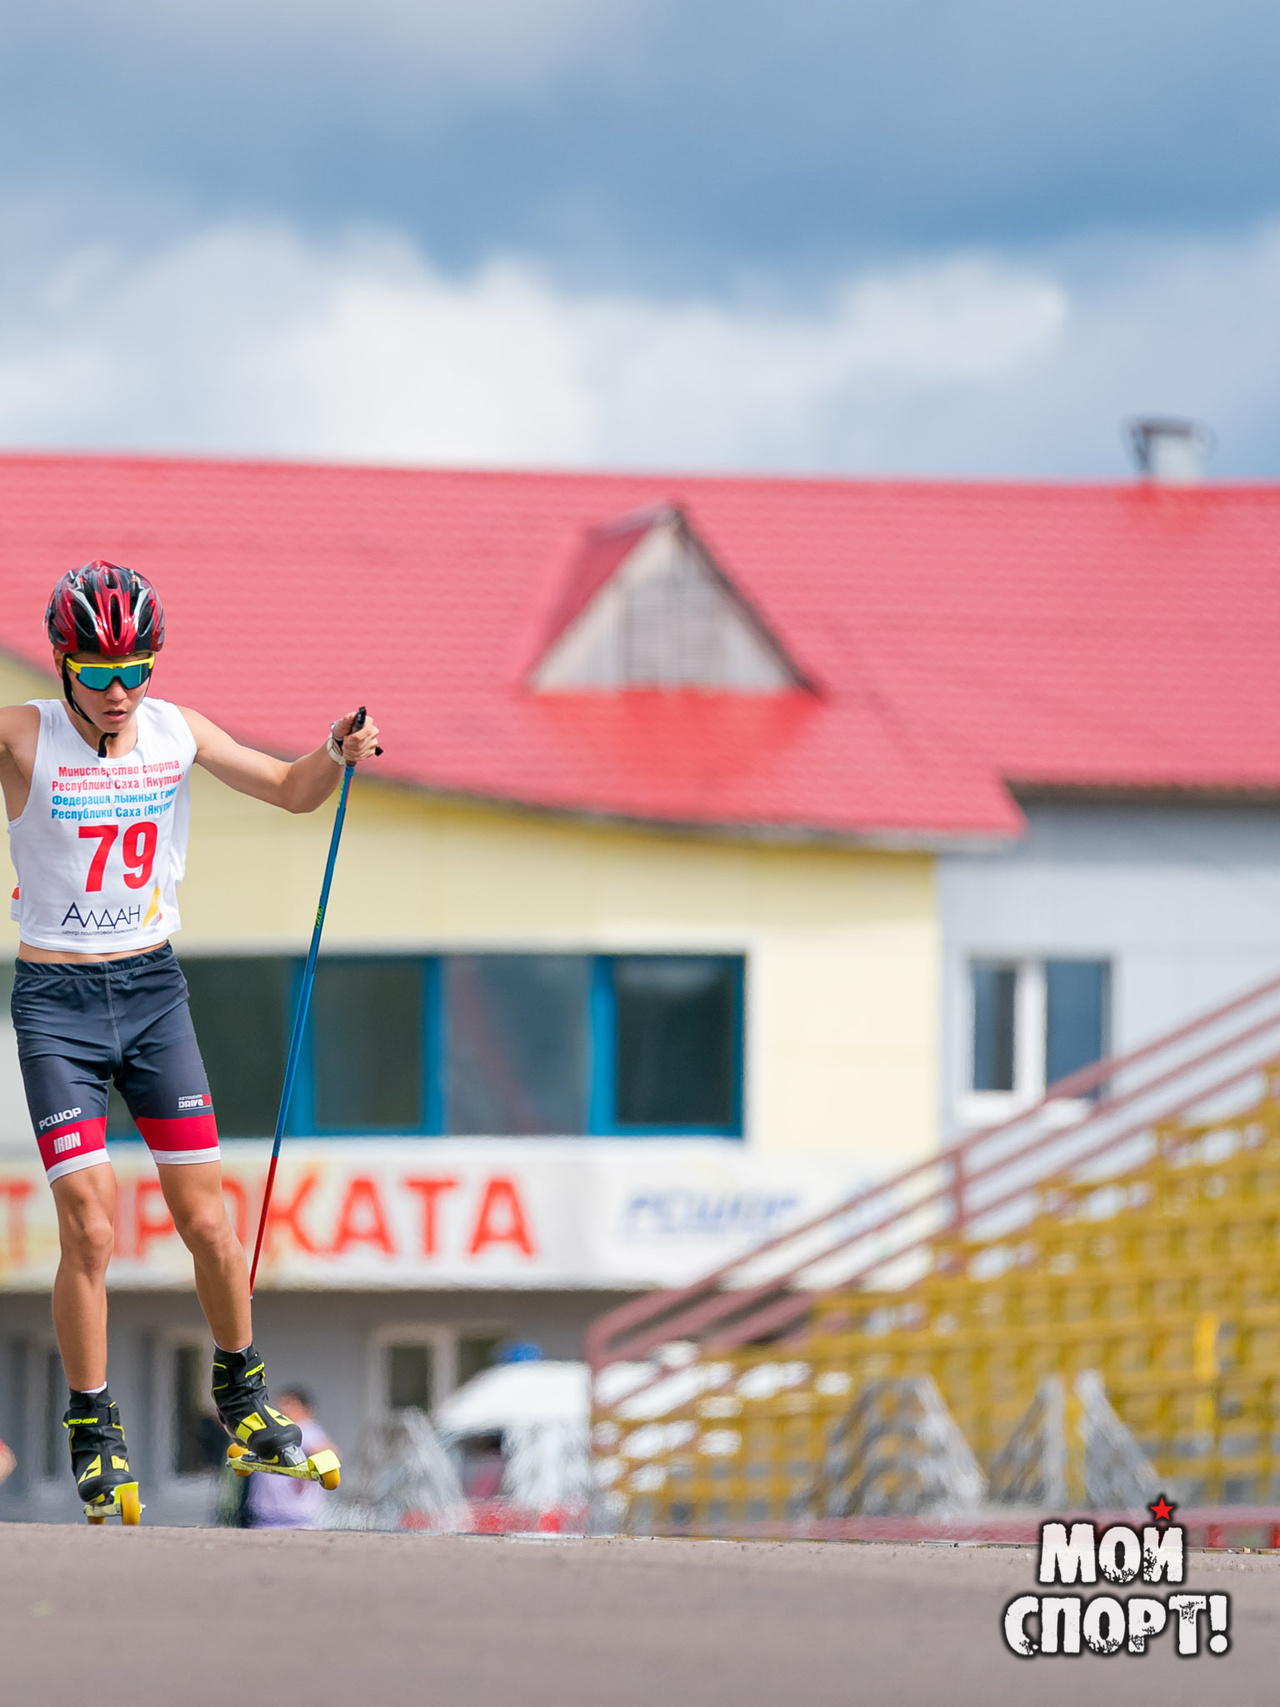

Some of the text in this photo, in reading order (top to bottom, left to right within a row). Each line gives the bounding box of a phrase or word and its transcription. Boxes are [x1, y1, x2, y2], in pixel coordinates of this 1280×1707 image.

[58, 760, 180, 778] Министерство спорта
[51, 780, 112, 793] Республики
[114, 779, 140, 790] Саха
[51, 795, 111, 807] Федерация
[114, 792, 158, 804] лыжных
[51, 808, 113, 821] Республики
[115, 807, 141, 818] Саха
[78, 821, 158, 893] 79
[38, 1107, 82, 1131] РСШОР
[53, 1131, 82, 1155] IRON
